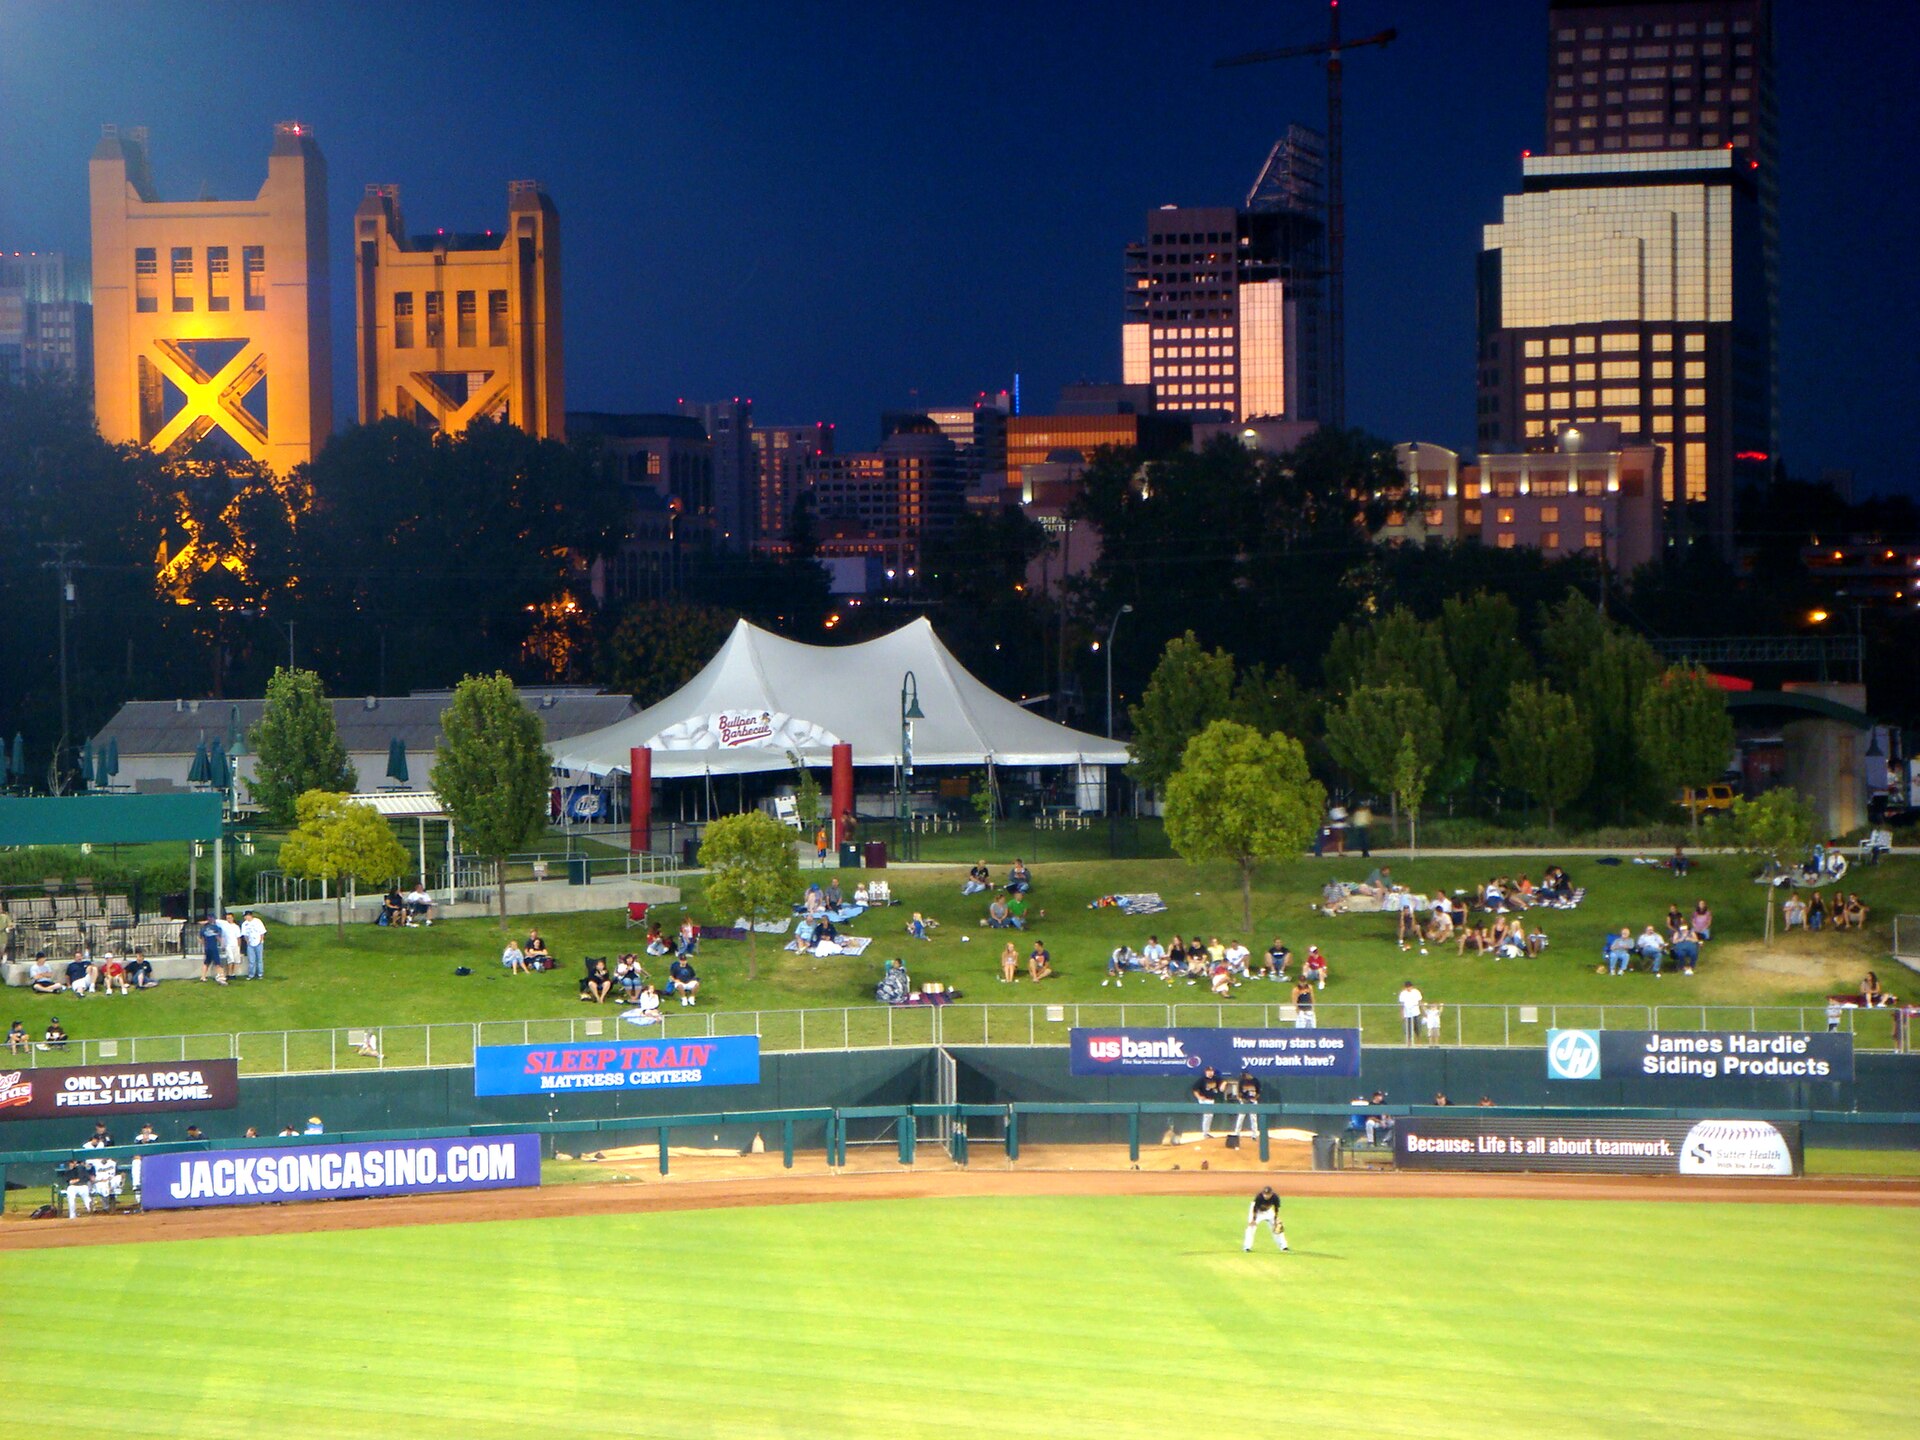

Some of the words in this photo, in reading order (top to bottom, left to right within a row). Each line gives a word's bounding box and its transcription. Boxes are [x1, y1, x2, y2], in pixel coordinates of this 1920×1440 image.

[719, 715, 757, 730] Bullpen
[721, 724, 770, 743] Barbecue
[1233, 1037, 1257, 1048] How
[1258, 1038, 1288, 1051] many
[1289, 1037, 1317, 1048] stars
[1318, 1037, 1344, 1048] does
[1646, 1035, 1723, 1053] James
[523, 1050, 617, 1074] SLEEP
[619, 1045, 711, 1070] TRAIN
[1241, 1056, 1274, 1069] your
[1275, 1055, 1302, 1066] bank
[1303, 1055, 1336, 1066] have?
[1643, 1056, 1717, 1078] Siding
[1724, 1056, 1830, 1076] Products
[65, 1075, 116, 1092] ONLY
[118, 1073, 147, 1089] TIA
[152, 1071, 204, 1086] ROSA
[540, 1072, 625, 1089] MATTRESS
[629, 1069, 702, 1085] CENTERS
[56, 1090, 113, 1107] FEELS
[115, 1087, 154, 1104] LIKE
[157, 1085, 213, 1101] HOME.
[1406, 1135, 1475, 1153] Because:
[1478, 1136, 1506, 1153] Life
[1510, 1137, 1523, 1153] is
[1527, 1137, 1546, 1154] all
[1550, 1138, 1593, 1155] about
[1595, 1139, 1675, 1156] teamwork.
[1716, 1149, 1746, 1160] Sutter
[1749, 1149, 1781, 1160] Health
[170, 1143, 516, 1201] JACKSONCASINO.COM
